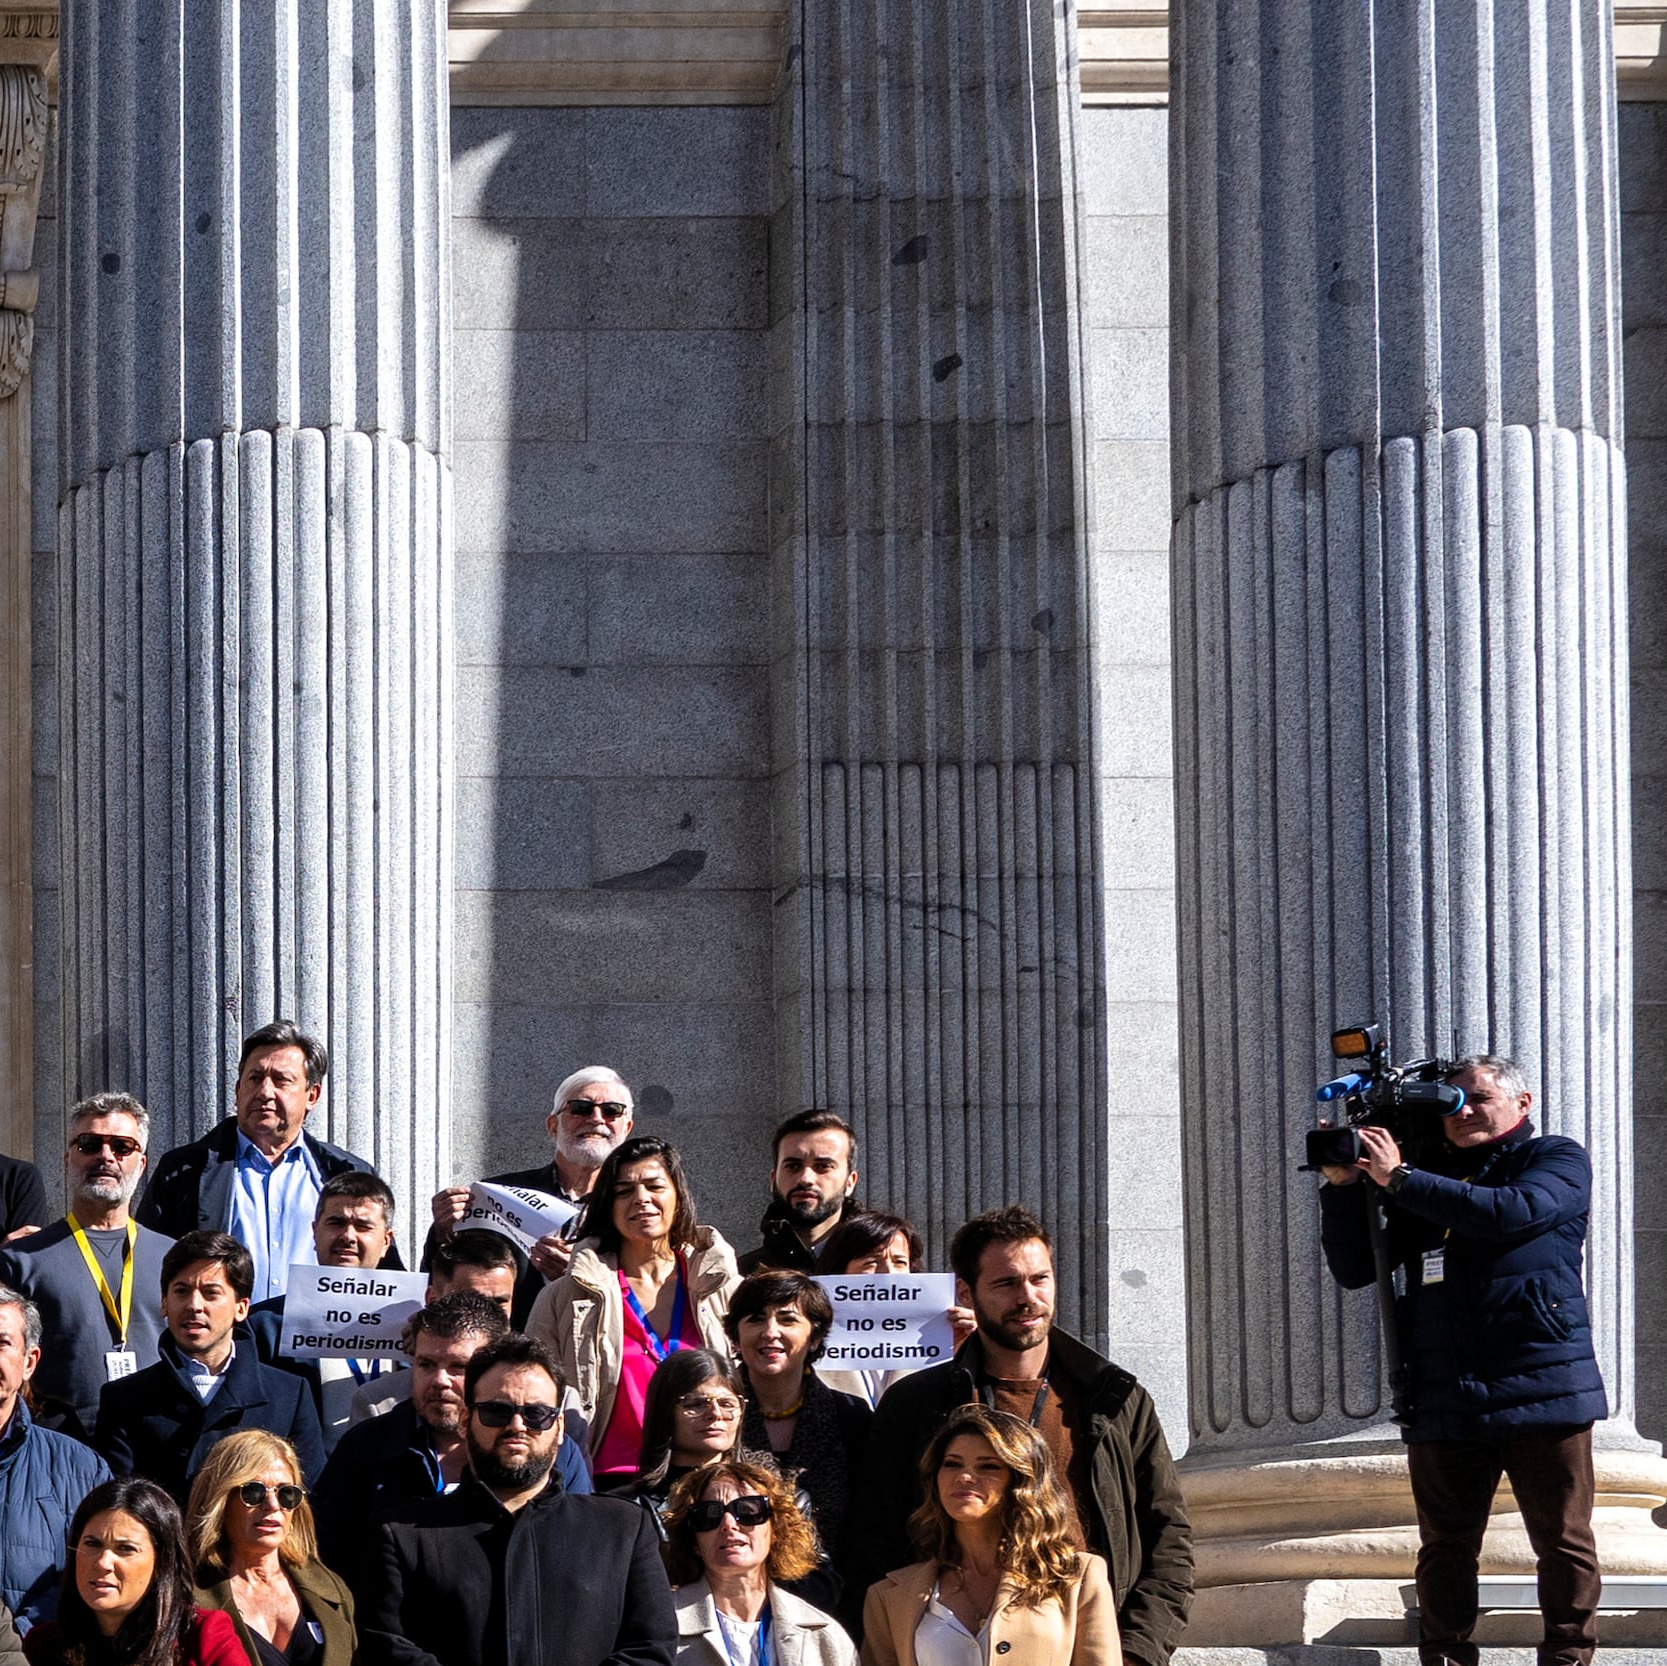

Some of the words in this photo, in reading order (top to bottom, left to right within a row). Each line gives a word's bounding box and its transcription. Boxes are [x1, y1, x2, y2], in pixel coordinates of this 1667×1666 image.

[487, 1196, 503, 1213] no
[506, 1211, 522, 1228] es
[316, 1276, 398, 1297] Señalar
[834, 1283, 922, 1302] Señalar
[325, 1309, 352, 1324] no
[357, 1311, 381, 1326] es
[846, 1318, 875, 1332] no
[881, 1317, 907, 1331] es
